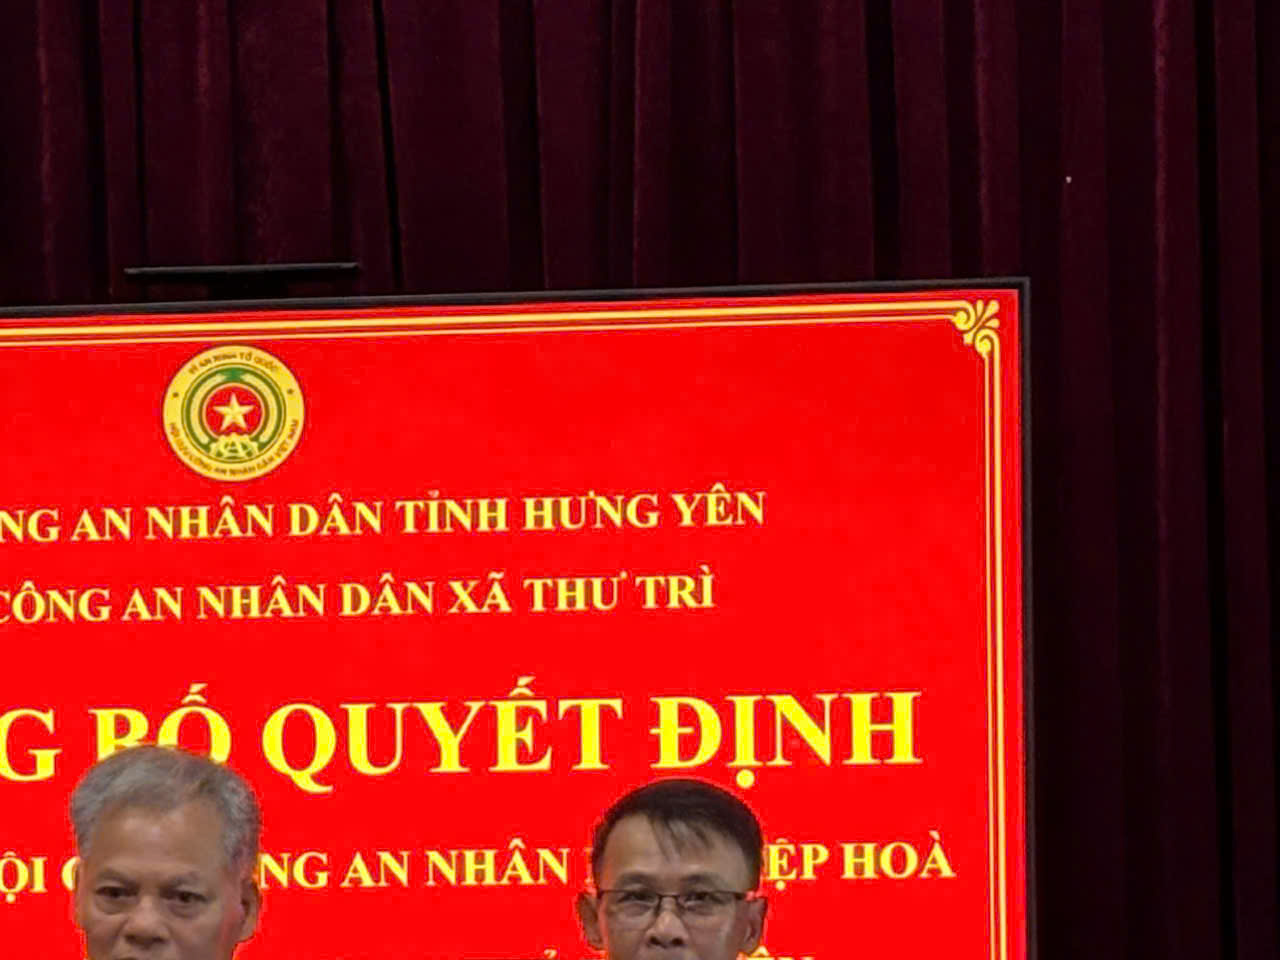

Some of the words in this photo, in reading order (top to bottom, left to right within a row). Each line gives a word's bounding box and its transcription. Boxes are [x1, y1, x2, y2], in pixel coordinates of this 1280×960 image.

[71, 506, 132, 541] AN
[145, 495, 274, 540] NHÂN
[289, 492, 383, 537] DÂN
[395, 490, 509, 534] TỈNH
[523, 491, 659, 531] HƯNG
[671, 482, 765, 527] YÊN
[122, 586, 183, 621] AN
[197, 575, 326, 619] NHÂN
[340, 572, 435, 617] DÂN
[448, 571, 512, 614] XÃ
[523, 572, 628, 612] THƯ
[635, 564, 715, 609] TRÌ
[87, 683, 232, 764] BỐ
[261, 676, 623, 793] QUYẾT
[649, 691, 924, 789] ĐỊNH
[258, 851, 329, 890] NG
[340, 850, 409, 888] AN
[425, 837, 569, 886] NHÂN
[841, 830, 956, 880] HOÀ
